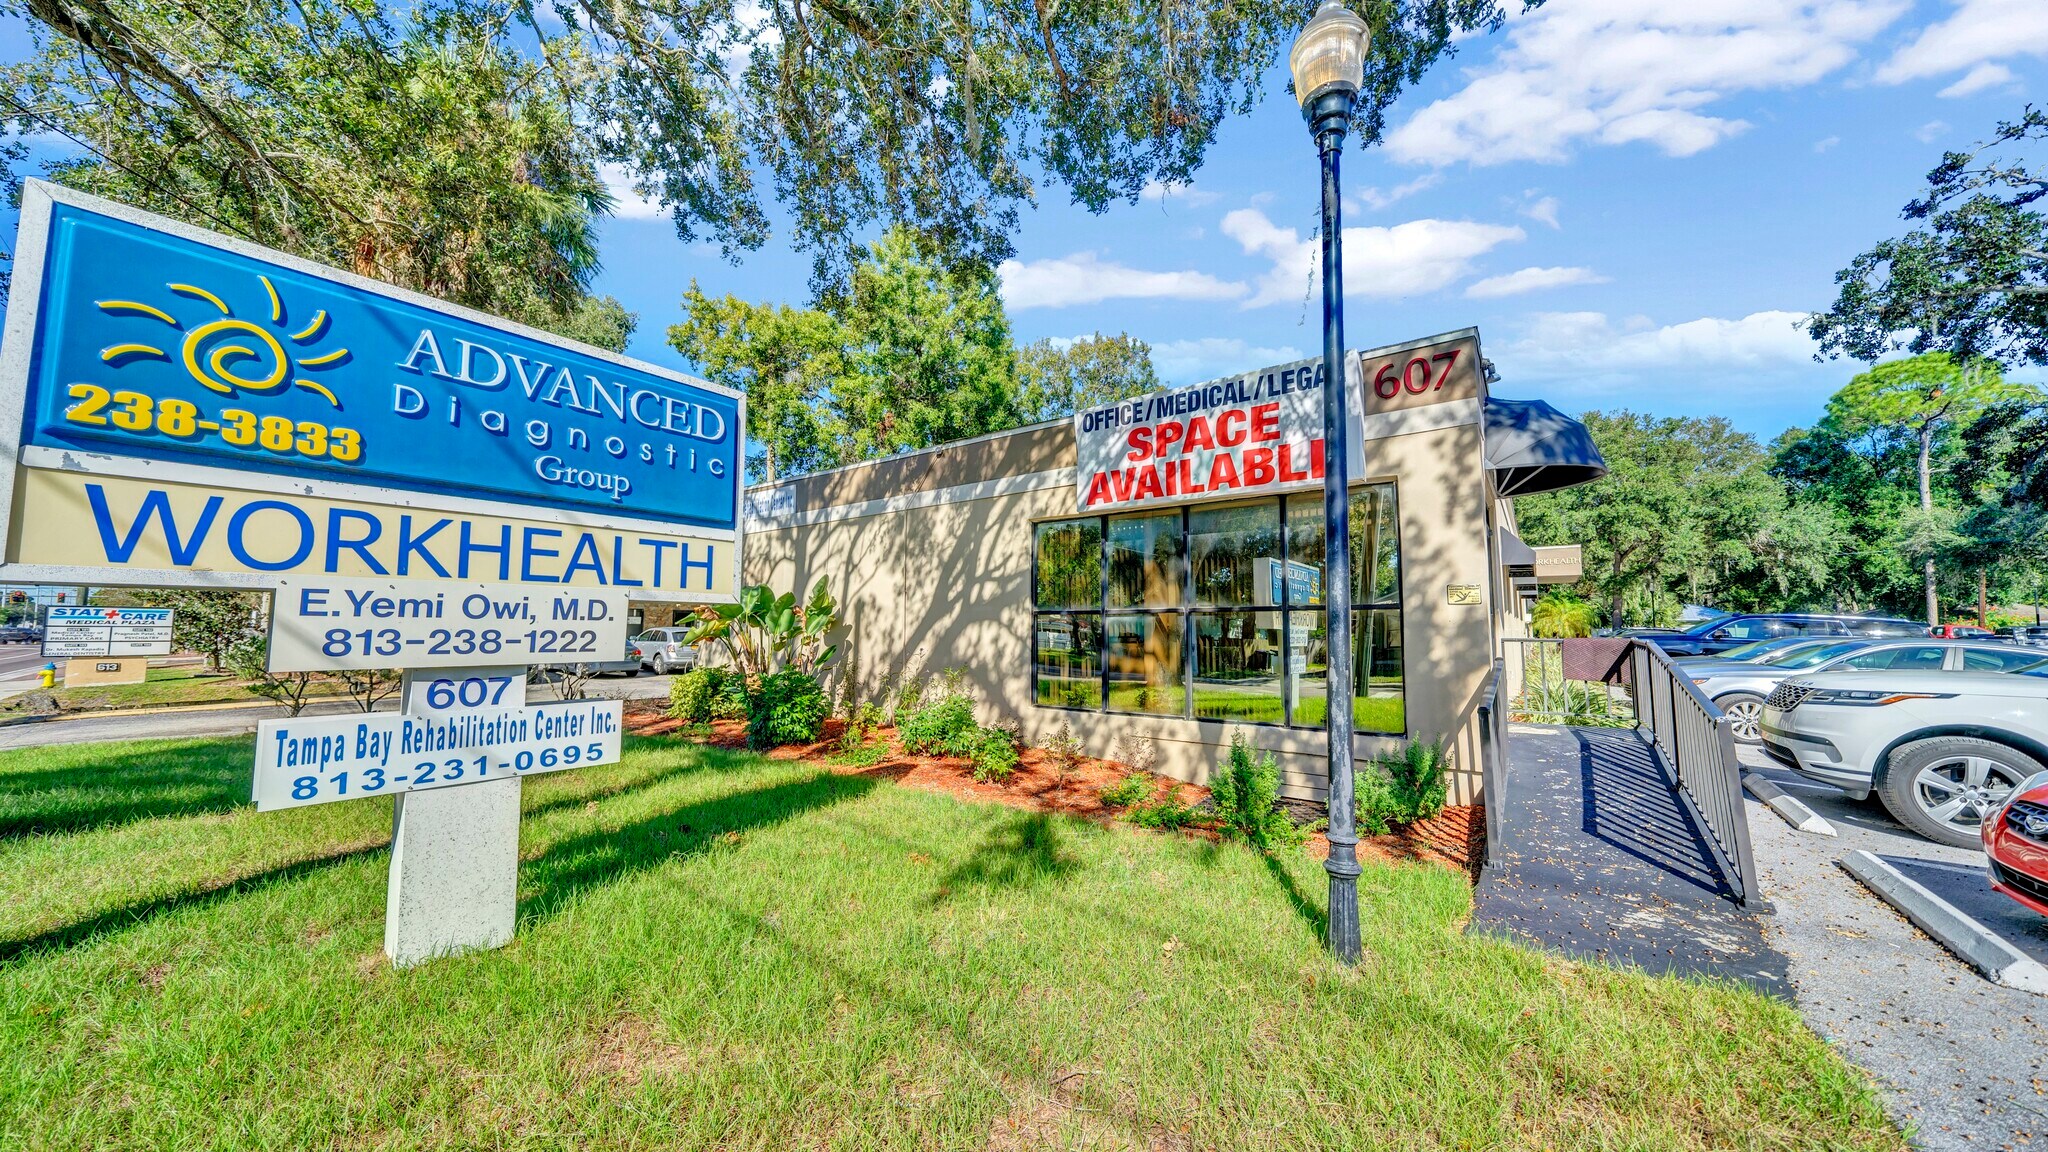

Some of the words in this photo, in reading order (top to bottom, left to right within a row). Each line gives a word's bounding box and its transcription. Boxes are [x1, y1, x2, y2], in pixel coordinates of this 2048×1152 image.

[399, 329, 727, 443] ADVANCED
[1082, 364, 1324, 433] OFFICE/MEDICAL/LEGA
[1373, 349, 1461, 399] 607
[64, 381, 364, 464] 238-3833
[393, 383, 726, 478] Diagnostic
[1127, 402, 1281, 462] SPACE
[533, 455, 633, 502] Group
[84, 483, 713, 592] WORKHEALTH
[1535, 557, 1581, 566] ORKHEALTH
[53, 608, 104, 616] STAT
[120, 613, 168, 621] CARE
[462, 591, 537, 623] Owi,
[552, 597, 614, 622] M.D.
[320, 628, 598, 658] 813-238-1222
[425, 676, 513, 710] 607
[275, 729, 345, 772] Tampa
[355, 723, 393, 766] Bay
[401, 713, 528, 755] Rehabilitation
[535, 709, 585, 741] Center
[590, 708, 617, 735] Inc.
[290, 742, 604, 802] 813-231-0695
